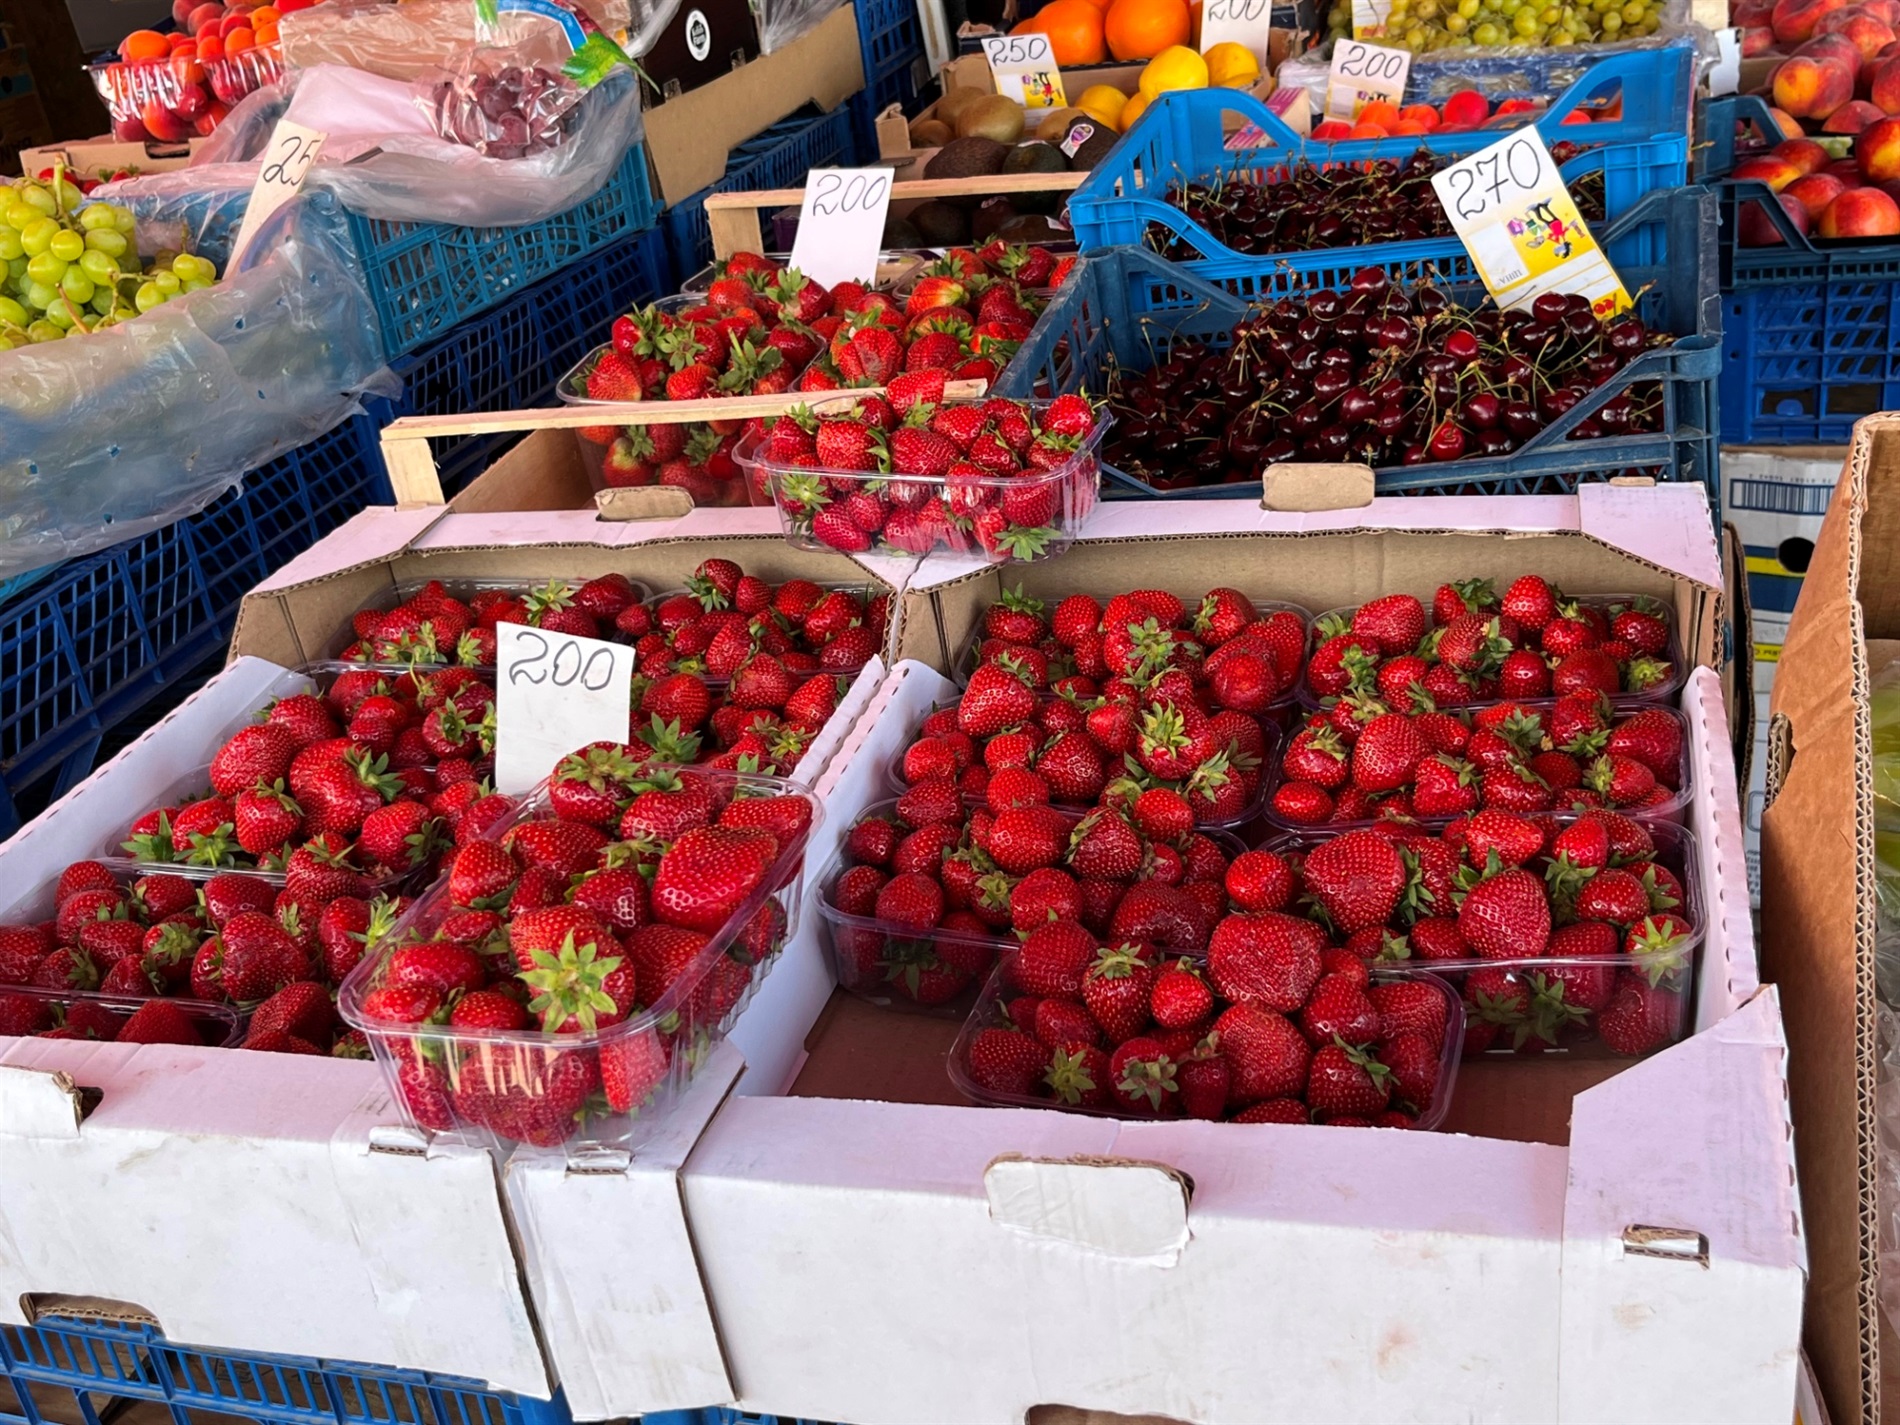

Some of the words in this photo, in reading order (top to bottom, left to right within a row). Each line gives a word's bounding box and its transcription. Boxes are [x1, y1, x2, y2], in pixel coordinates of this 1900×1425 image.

[988, 37, 1047, 67] 250
[1340, 45, 1403, 80] 200
[813, 174, 887, 216] 200
[1449, 139, 1541, 220] 270
[509, 631, 615, 691] 200
